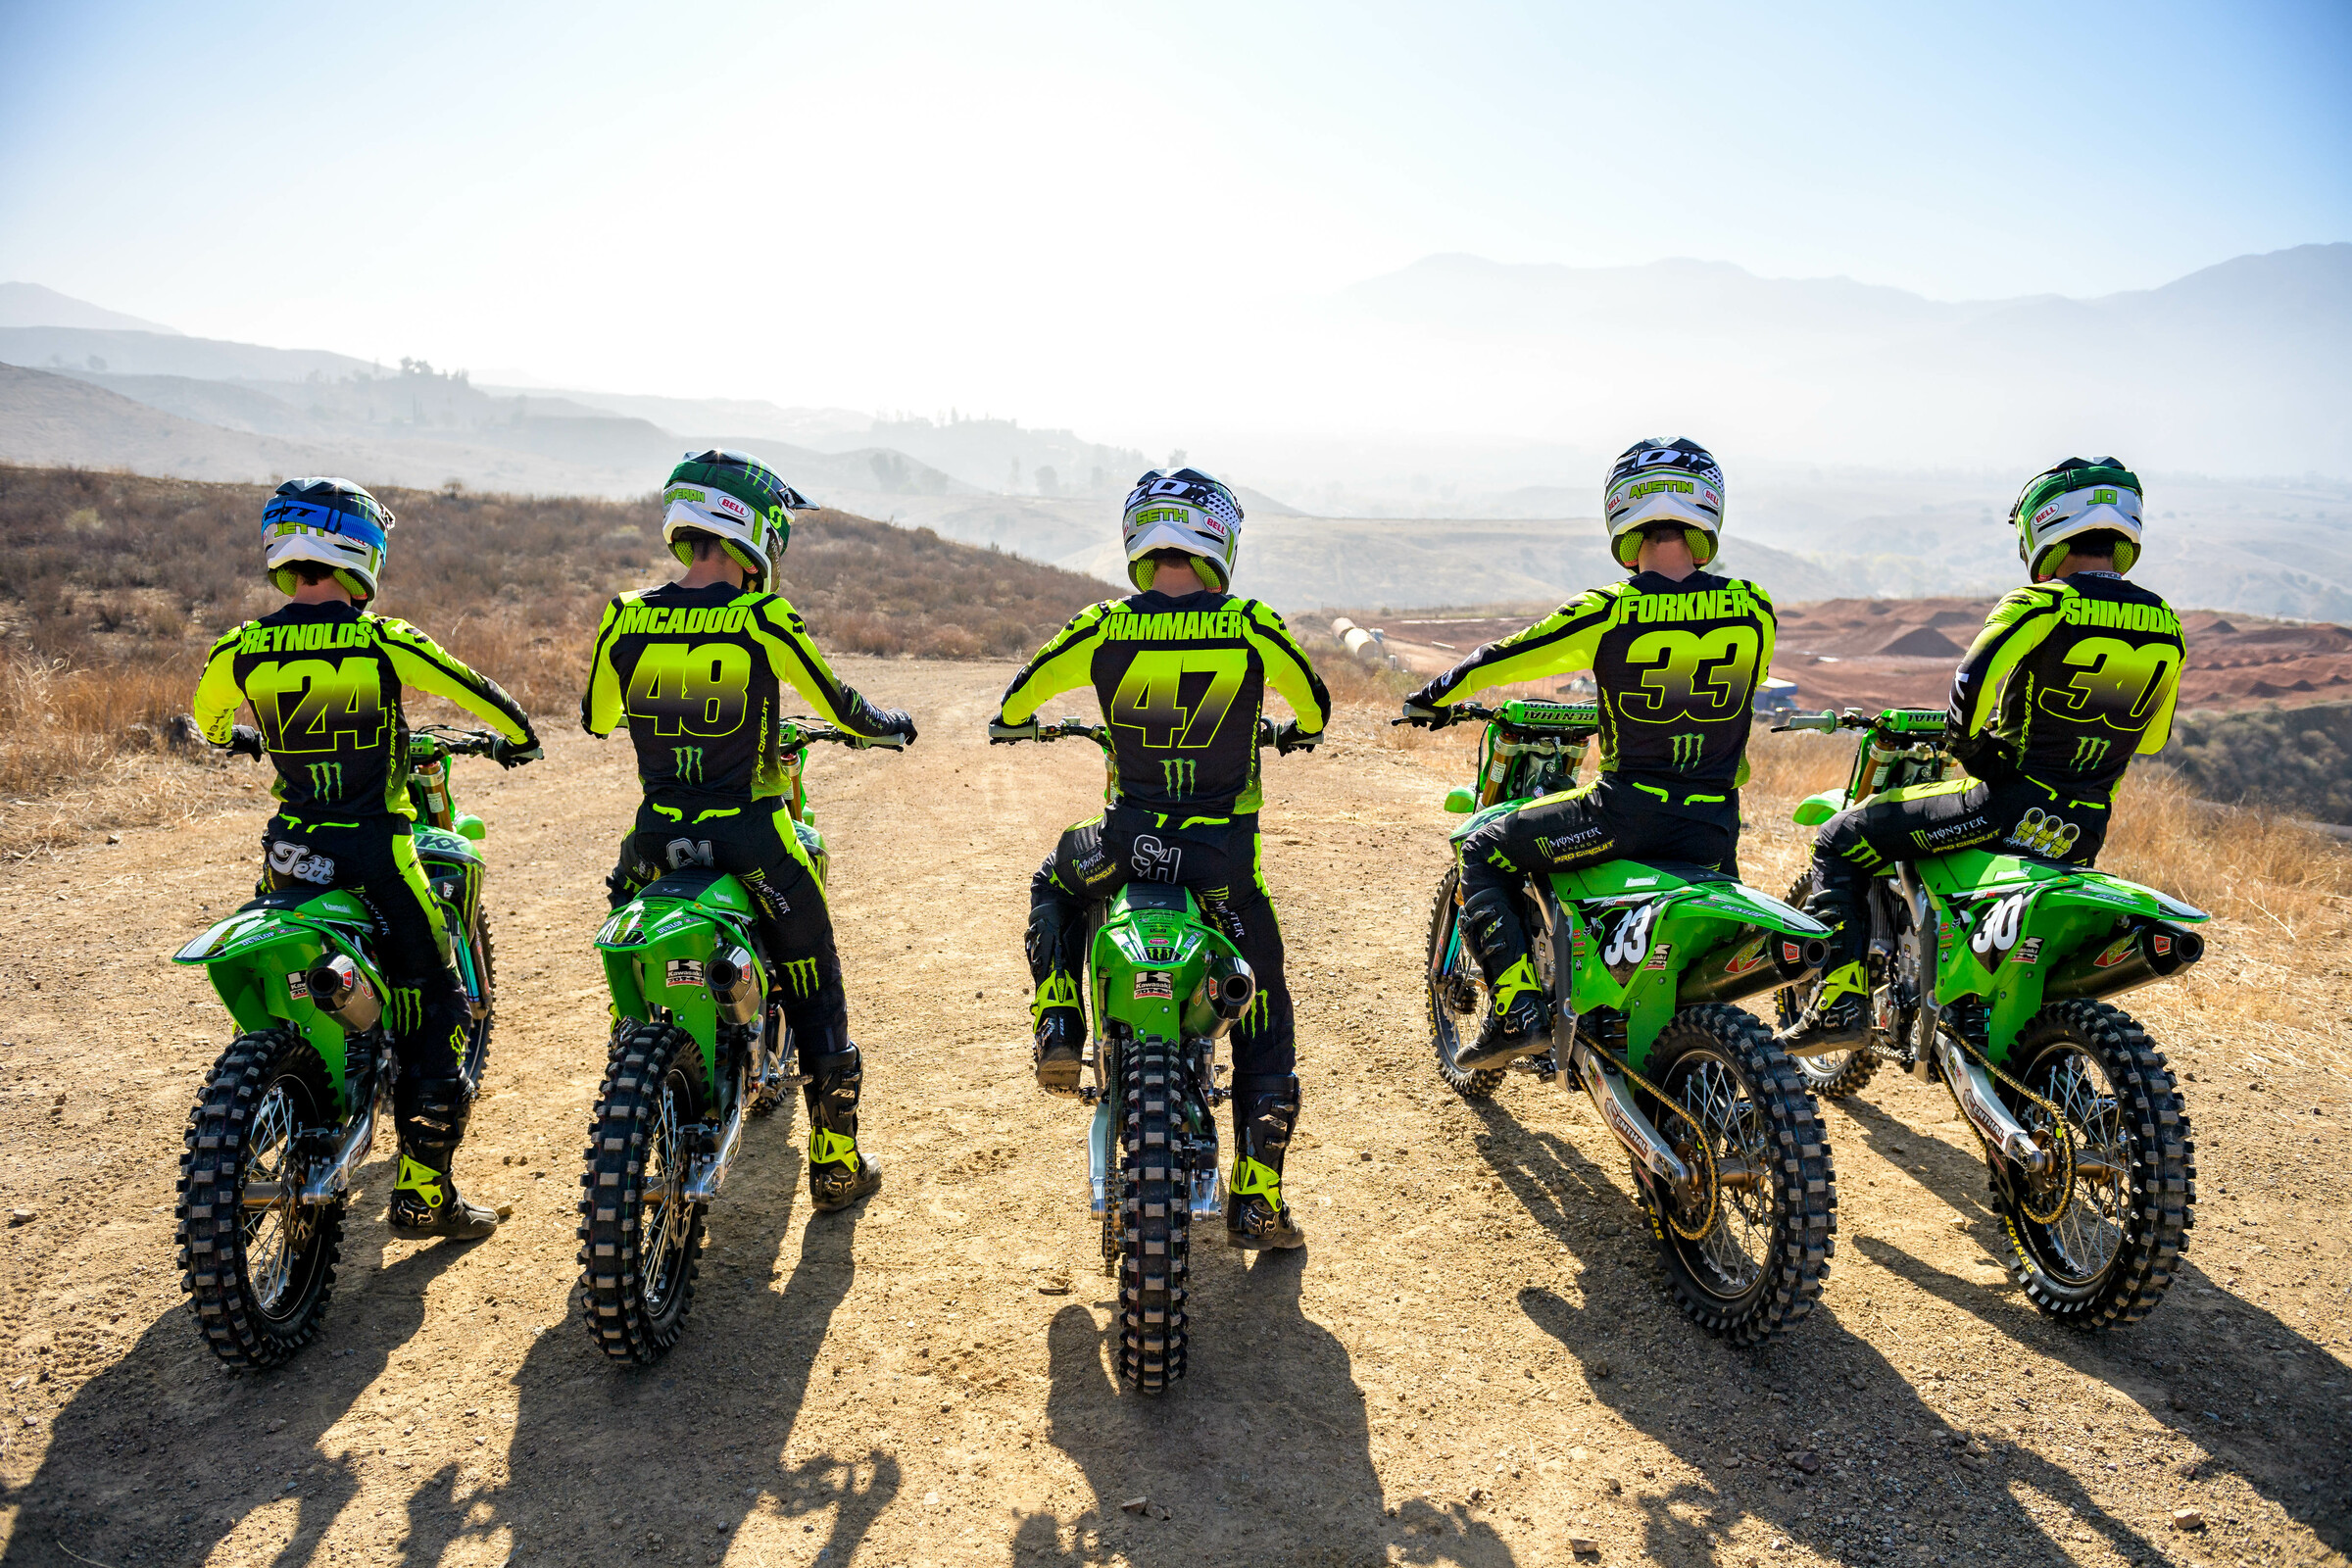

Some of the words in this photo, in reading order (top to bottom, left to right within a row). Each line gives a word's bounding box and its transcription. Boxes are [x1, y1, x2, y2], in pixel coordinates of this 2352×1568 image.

[1607, 495, 1621, 512] BELL
[1628, 479, 1694, 500] AUSTIN
[1705, 490, 1719, 507] BELL
[2086, 488, 2118, 506] JO
[721, 498, 745, 515] BELL
[1136, 508, 1189, 526] SETH
[2034, 506, 2056, 524] BELL
[274, 521, 324, 538] JETT
[1206, 517, 1225, 535] BELL
[621, 605, 749, 635] MCADOO
[1619, 588, 1750, 624] FORKNER
[2062, 597, 2180, 636] SHIMODA
[241, 622, 373, 655] REYNOLDS
[1108, 610, 1243, 642] HAMMAKER
[1618, 625, 1759, 723] 33
[2025, 670, 2034, 703] PRO
[2037, 636, 2181, 731] 30
[626, 642, 752, 737] 48
[1111, 648, 1249, 749] 47
[245, 656, 387, 754] 124
[1523, 710, 1596, 721] RENTHAL
[759, 697, 770, 754] CIRCUIT
[1549, 826, 1602, 848] MONSTER
[1927, 815, 1987, 842] MONSTER
[1959, 828, 2001, 848] CIRCUIT
[416, 835, 466, 852] KX
[1553, 852, 1575, 863] PRO
[1576, 839, 1615, 858] CIRCUIT
[269, 841, 334, 884] Jett
[1131, 834, 1182, 884] SH
[656, 919, 684, 934] DUNLOP
[1603, 904, 1652, 966] 33
[1972, 893, 2024, 954] 30
[240, 931, 275, 947] DUNLOP
[2005, 1215, 2036, 1274] DUNLOP
